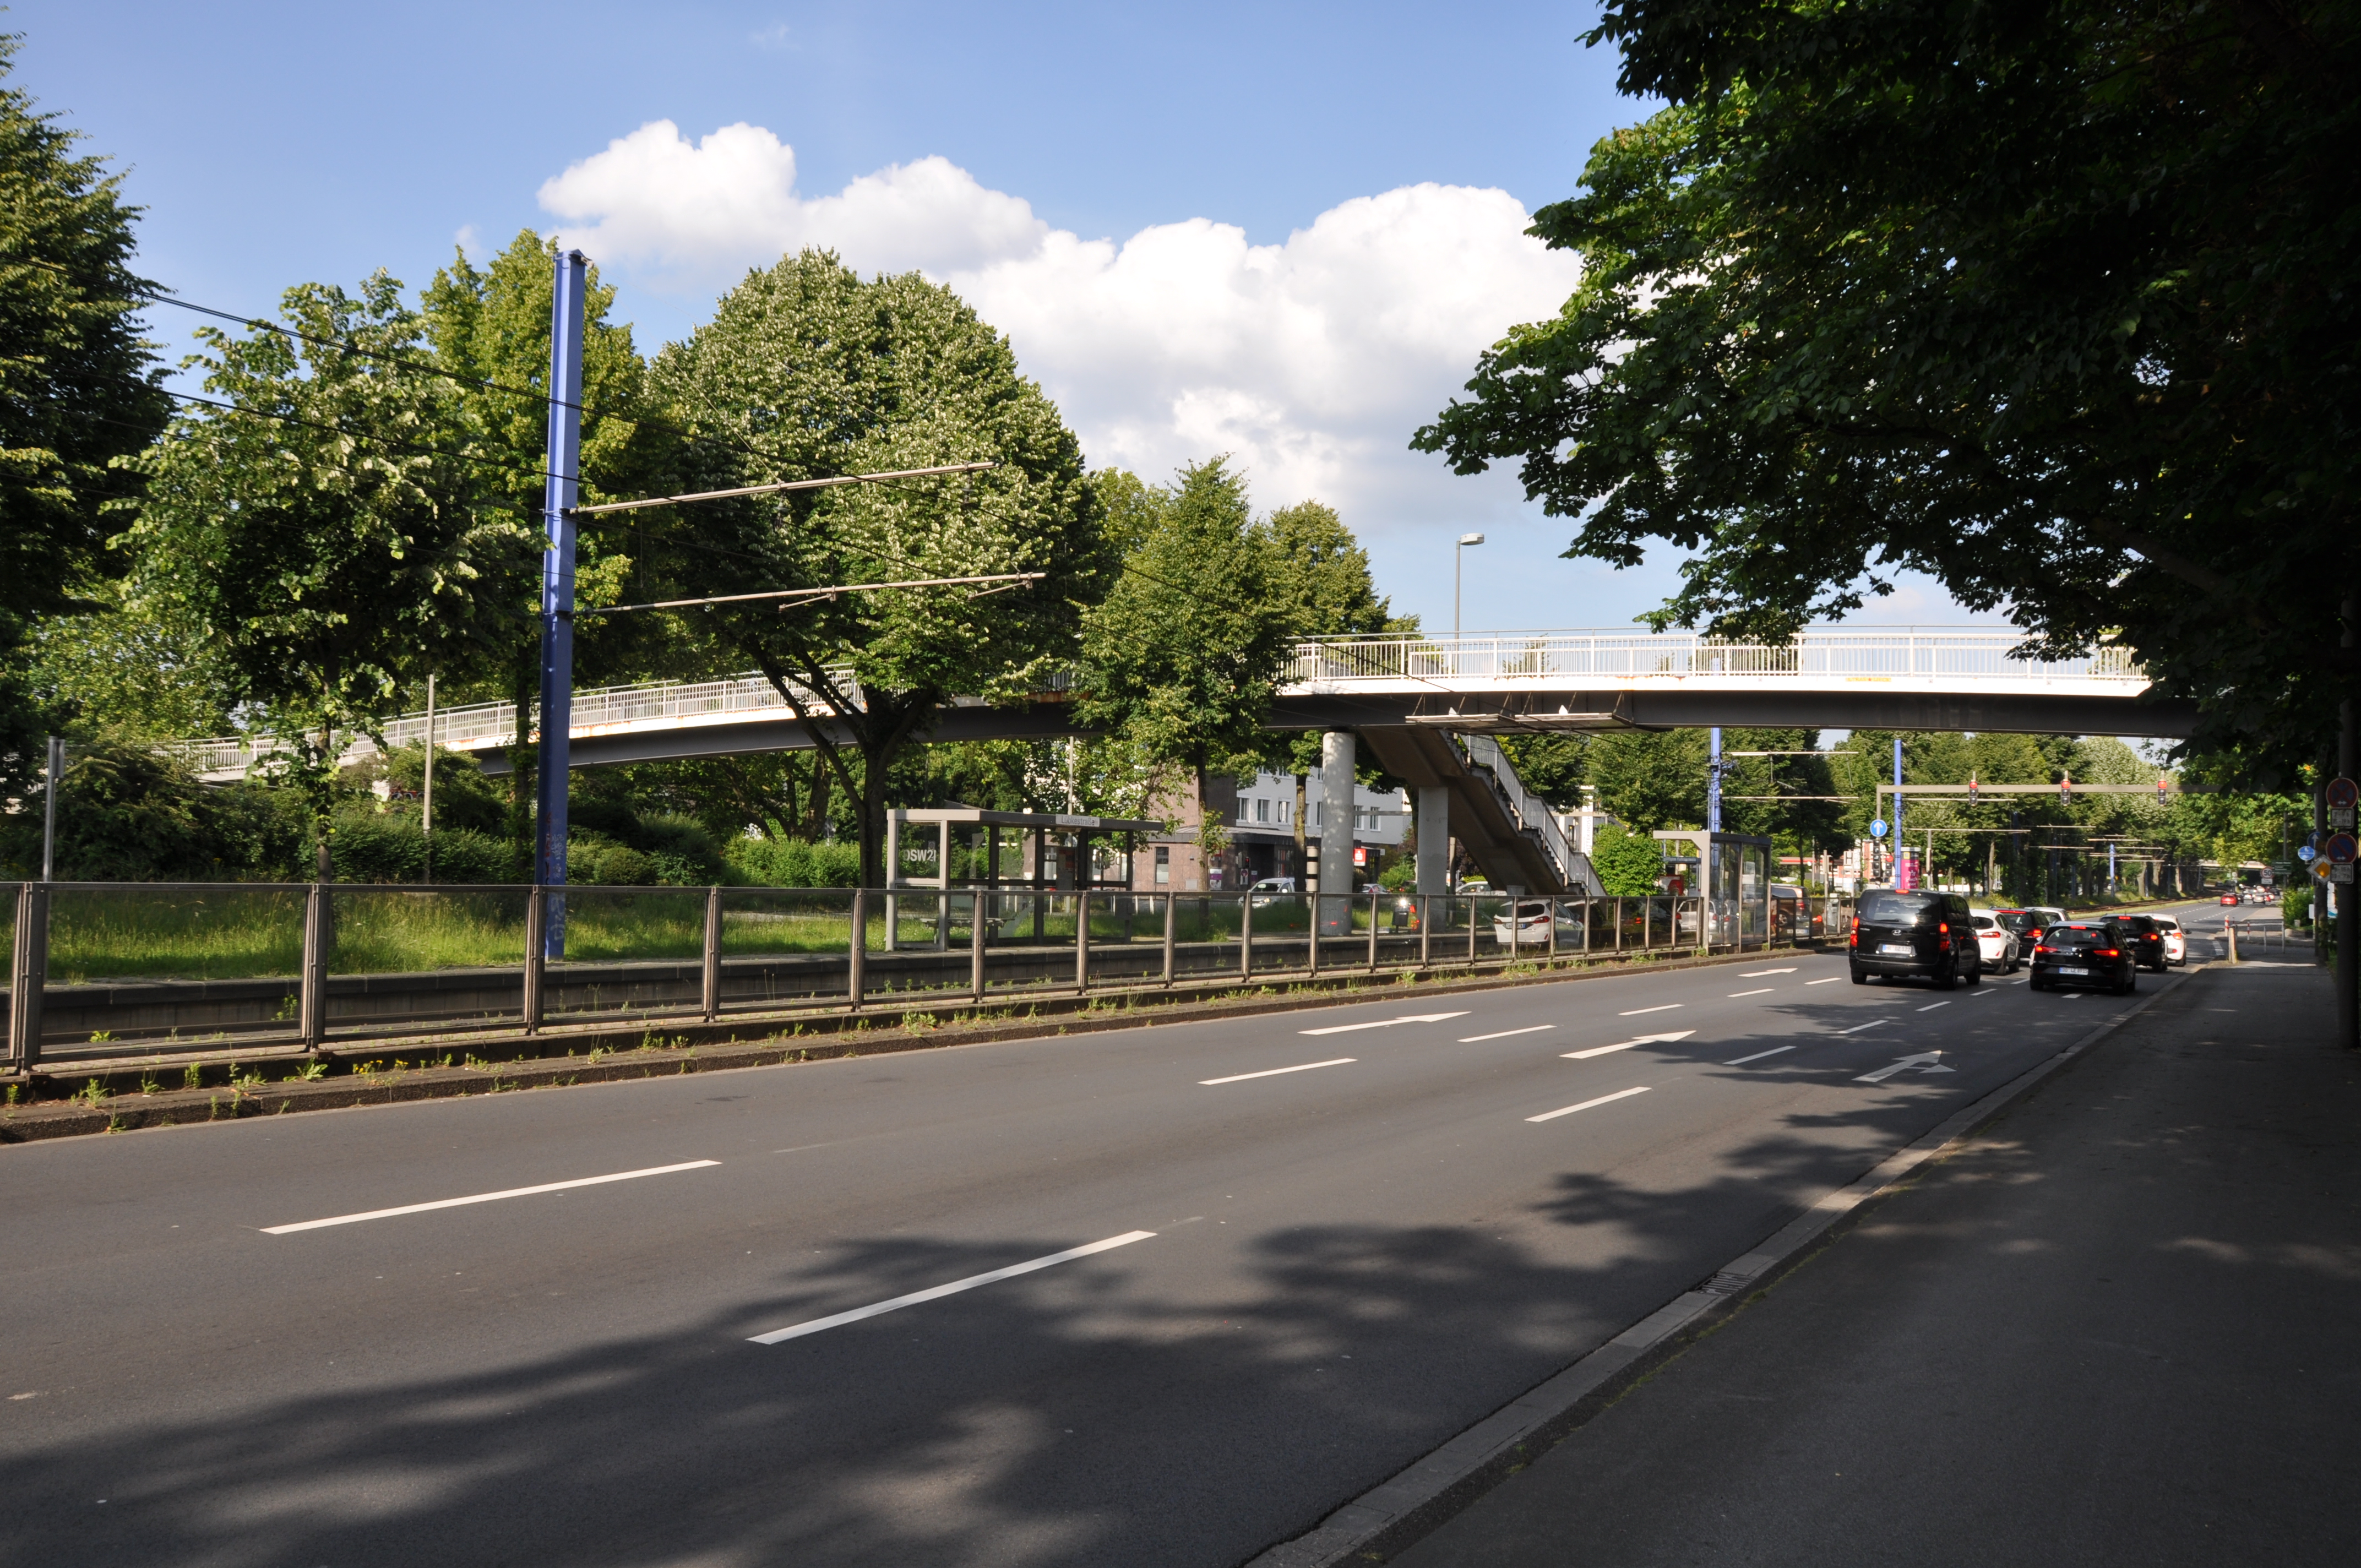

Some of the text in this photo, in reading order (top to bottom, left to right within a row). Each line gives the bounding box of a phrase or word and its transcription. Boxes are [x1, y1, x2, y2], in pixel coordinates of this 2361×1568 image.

[1062, 815, 1095, 826] Lübkestraße
[903, 849, 936, 862] DSW21
[1846, 852, 1853, 864] H
